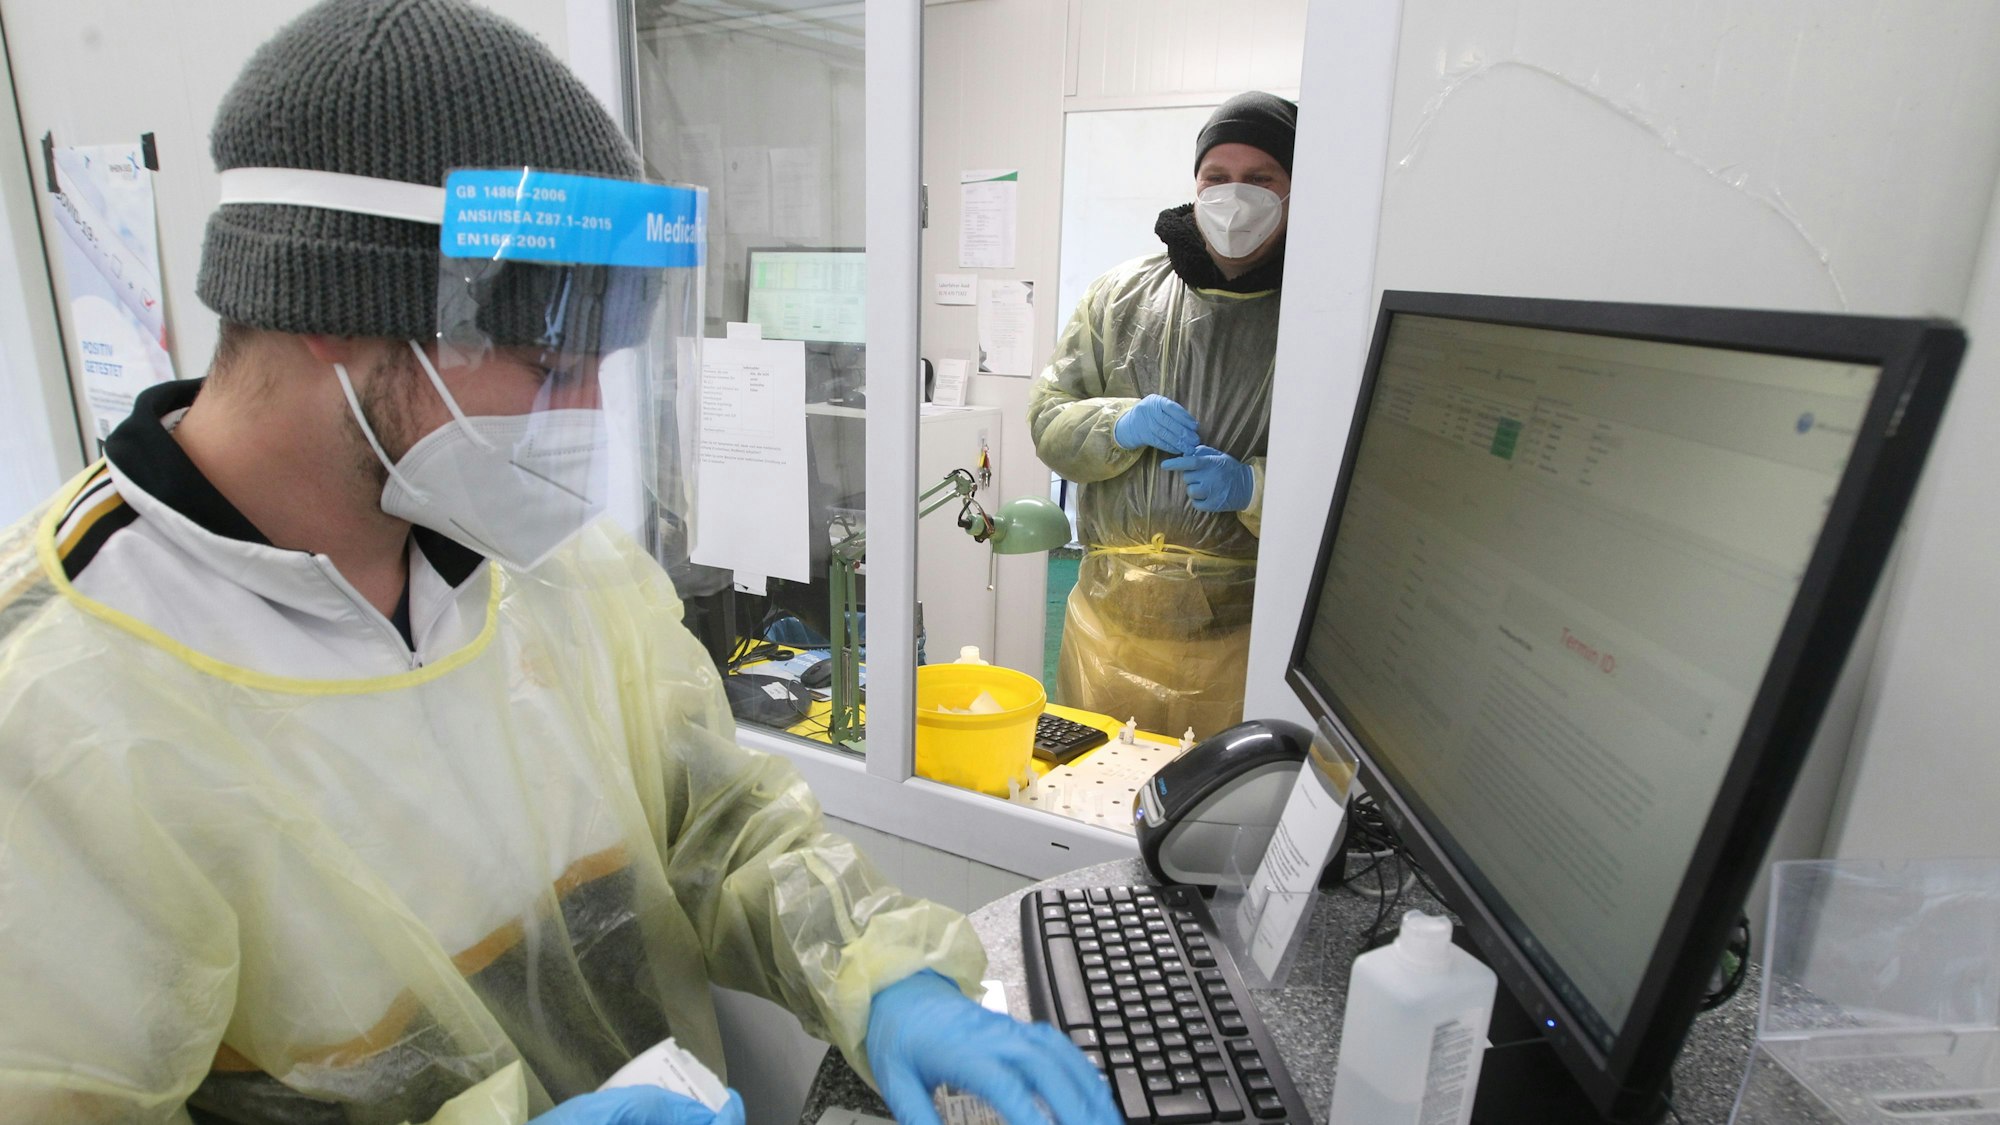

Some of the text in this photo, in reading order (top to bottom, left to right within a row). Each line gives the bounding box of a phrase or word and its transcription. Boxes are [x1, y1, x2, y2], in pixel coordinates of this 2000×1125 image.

[456, 185, 476, 198] GB
[457, 209, 612, 231] ANSI/ISEA Z87.1-2015
[82, 340, 113, 356] POSITIV
[85, 360, 123, 378] GETESTET
[1561, 626, 1598, 662] Termin
